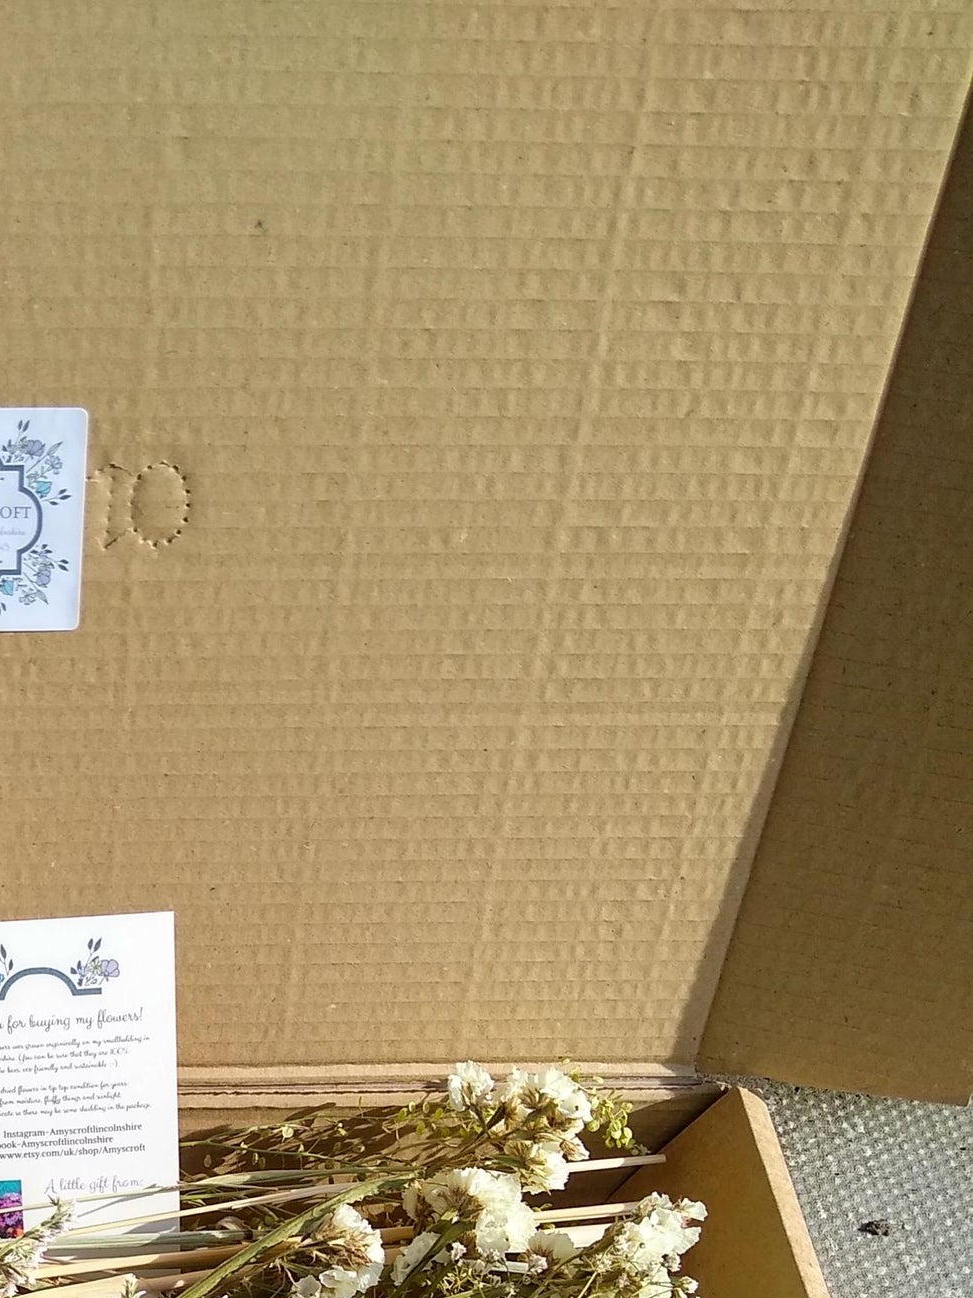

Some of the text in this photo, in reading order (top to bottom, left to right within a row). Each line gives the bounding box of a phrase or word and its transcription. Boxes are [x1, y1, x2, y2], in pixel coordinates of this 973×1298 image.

[7, 1014, 26, 1035] for
[29, 1013, 71, 1033] buying
[75, 1016, 92, 1030] my
[97, 1006, 143, 1030] flowers!
[47, 1051, 54, 1059] be
[69, 1050, 82, 1058] that
[83, 1049, 96, 1060] they
[34, 1063, 58, 1075] friendly
[60, 1062, 73, 1070] and
[74, 1059, 107, 1070] sustainable
[0, 1085, 16, 1095] dried
[17, 1085, 39, 1096] flowers
[48, 1084, 57, 1093] tip
[58, 1083, 69, 1093] top
[70, 1080, 98, 1090] condition
[100, 1079, 109, 1091] for
[0, 1098, 14, 1108] from
[43, 1095, 61, 1106] fluffy
[62, 1094, 81, 1103] things
[82, 1092, 95, 1100] and
[23, 1108, 38, 1116] there
[40, 1109, 53, 1117] may
[79, 1103, 106, 1113] shedding
[115, 1102, 125, 1110] the
[3, 1122, 143, 1140] Instagram-Amyscroftlincolnshire
[44, 1178, 58, 1194] A
[59, 1176, 85, 1191] little
[89, 1175, 108, 1194] gift
